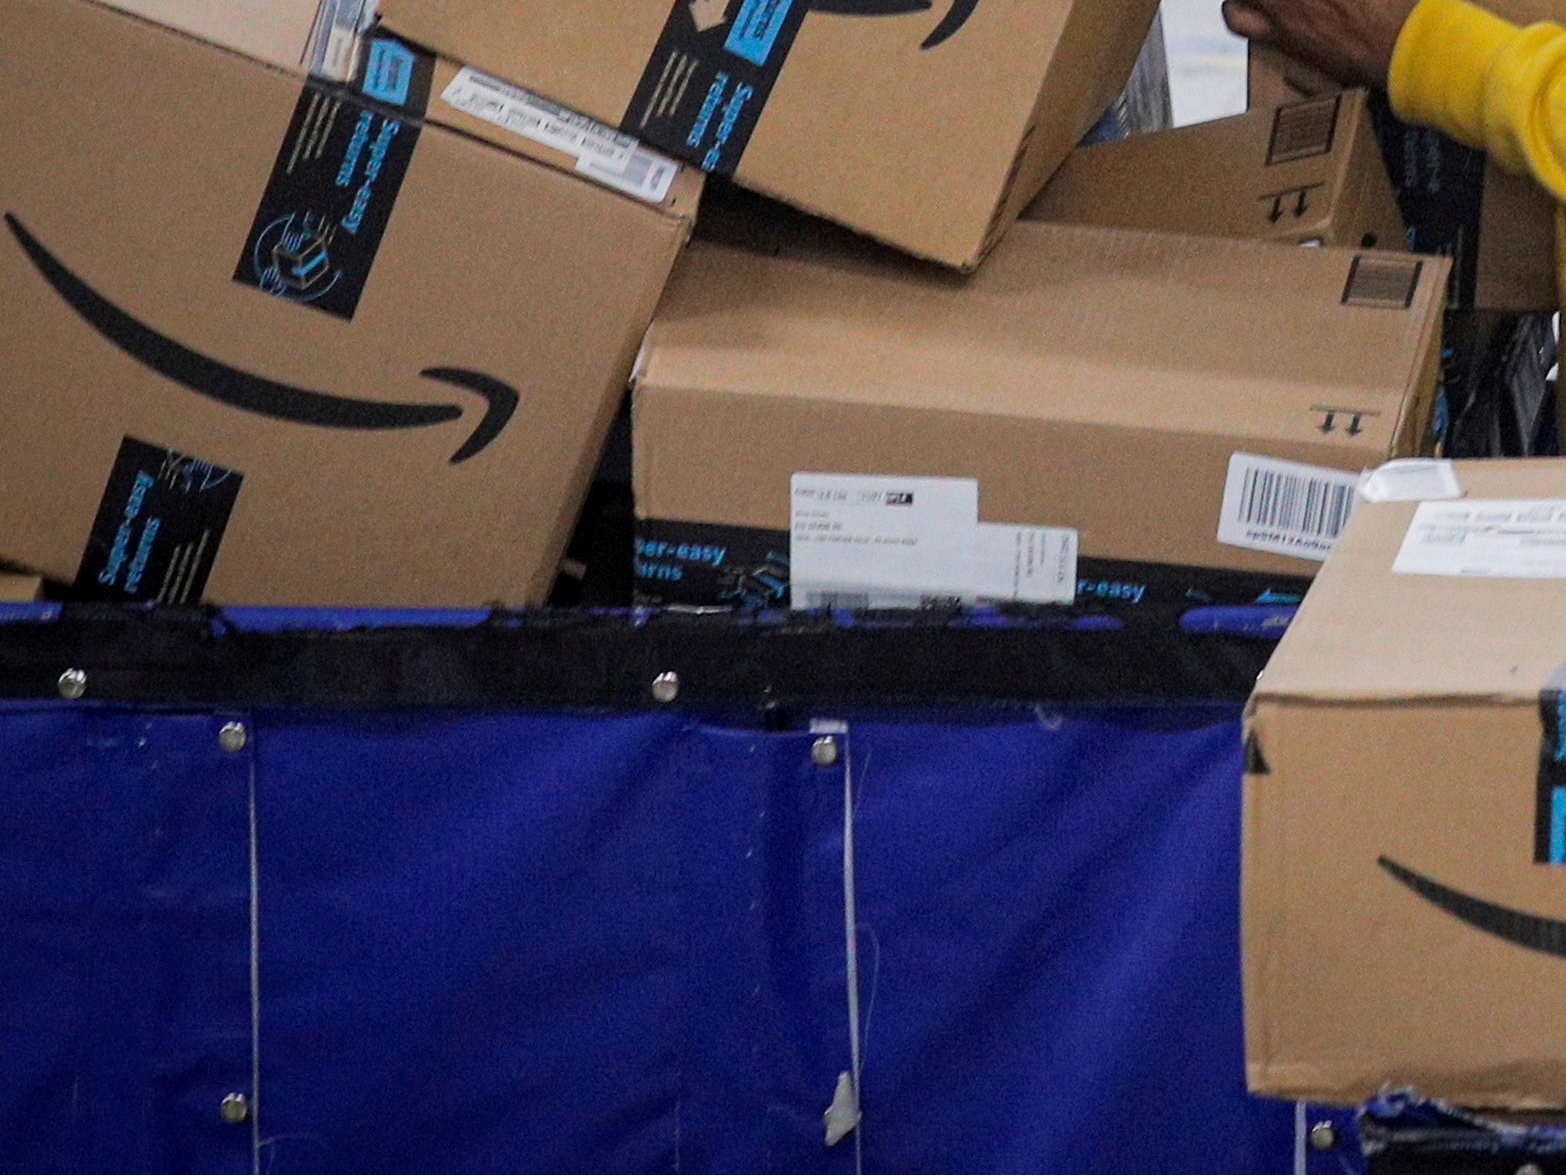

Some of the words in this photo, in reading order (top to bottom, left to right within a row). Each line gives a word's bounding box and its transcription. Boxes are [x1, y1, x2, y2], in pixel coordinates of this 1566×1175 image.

[686, 72, 728, 147] returns
[336, 110, 374, 186] returns
[340, 120, 400, 233] Super-easy
[98, 470, 154, 585] Super-easy
[126, 517, 160, 592] returns
